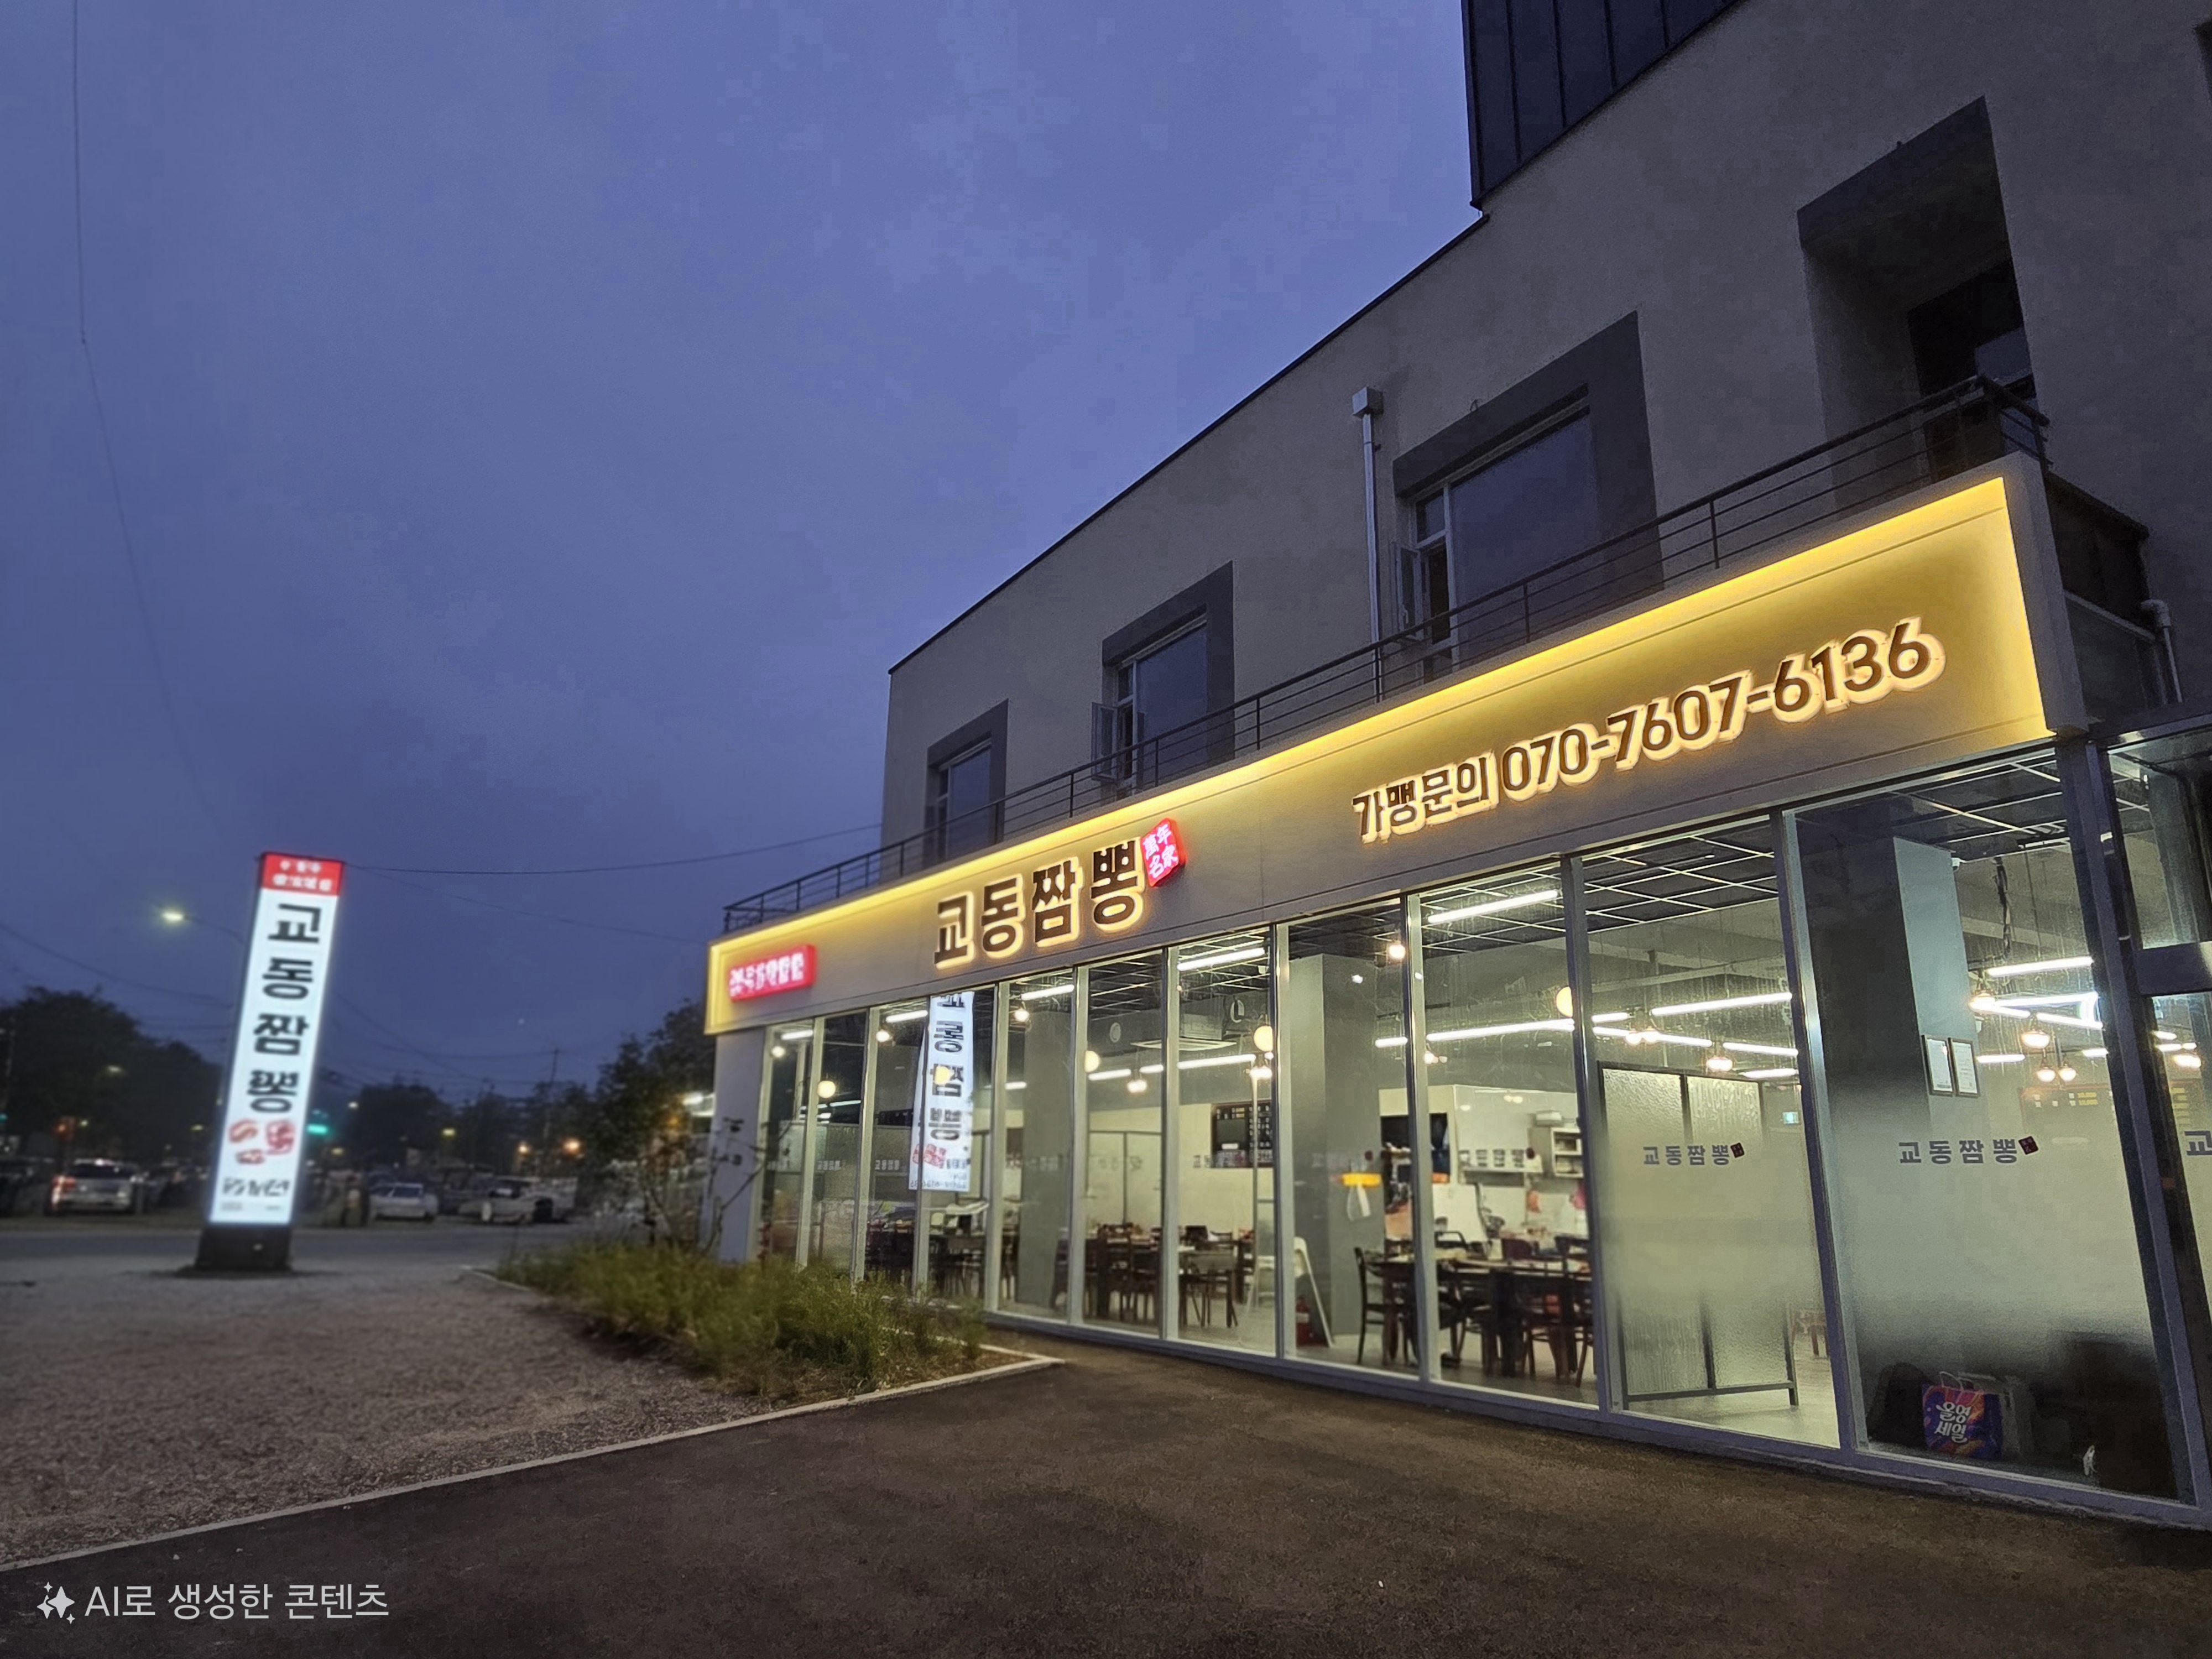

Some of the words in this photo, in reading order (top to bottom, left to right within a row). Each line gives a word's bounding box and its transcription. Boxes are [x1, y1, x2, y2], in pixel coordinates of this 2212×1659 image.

[1353, 755, 1498, 842] 가맹문의
[1502, 617, 1942, 800] 070-7607-6136
[933, 838, 1141, 967] 교동짬뽕
[247, 904, 322, 1113] 교동짬뽕
[1643, 1145, 1730, 1166] 교동짬뽕
[1898, 1139, 2017, 1164] 교동짬뽕
[1936, 1401, 1971, 1423] 올영
[1934, 1421, 1968, 1443] 세일
